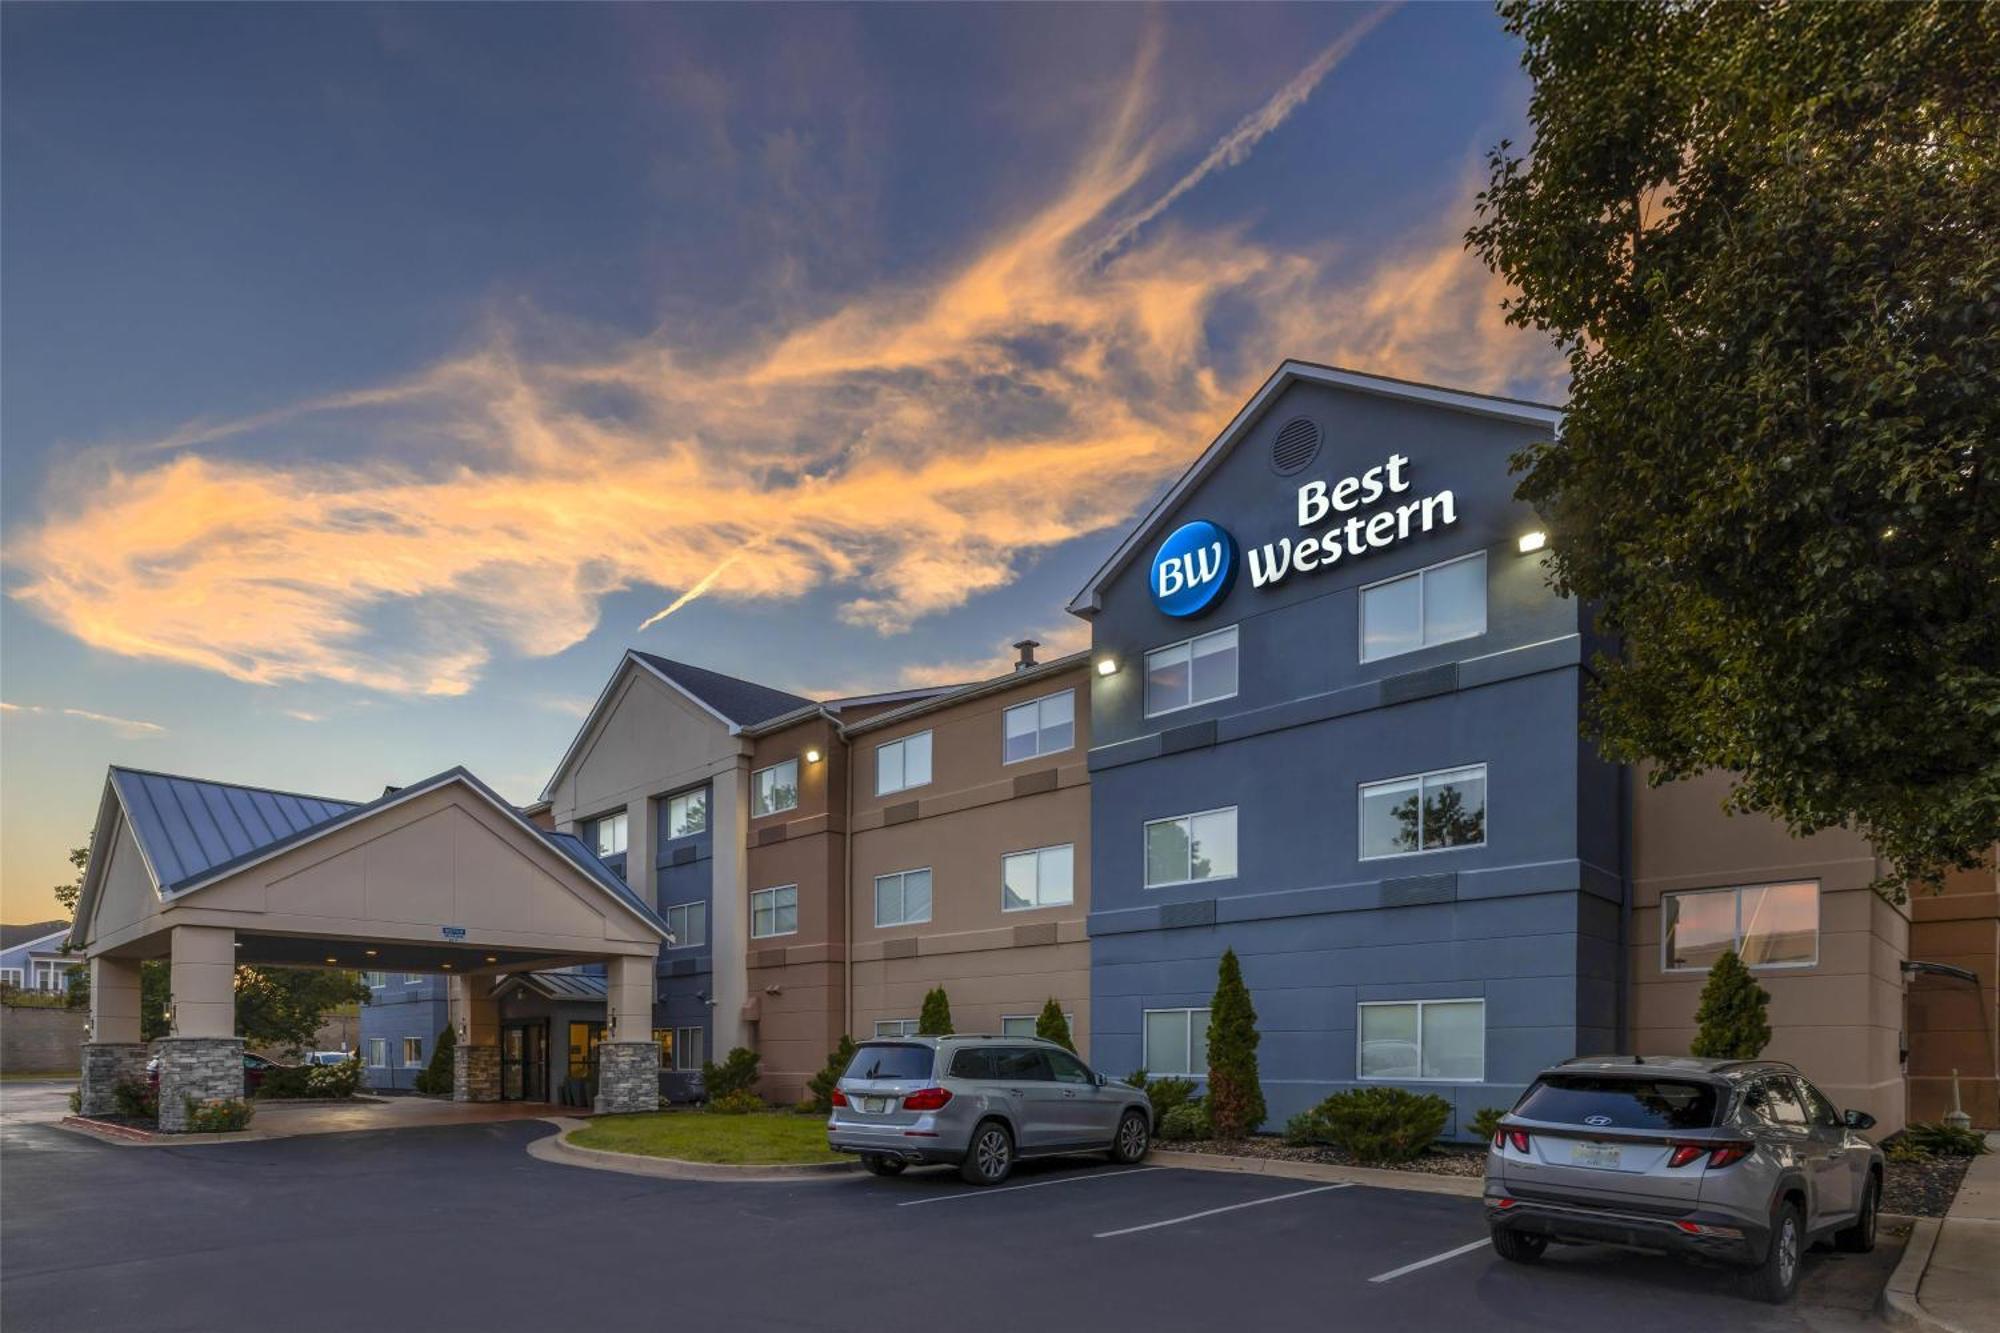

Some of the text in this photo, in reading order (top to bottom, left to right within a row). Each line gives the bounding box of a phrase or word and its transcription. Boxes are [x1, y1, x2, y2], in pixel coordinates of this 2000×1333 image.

[1298, 454, 1409, 526] Best
[1159, 542, 1222, 597] BW
[1248, 490, 1456, 588] Western
